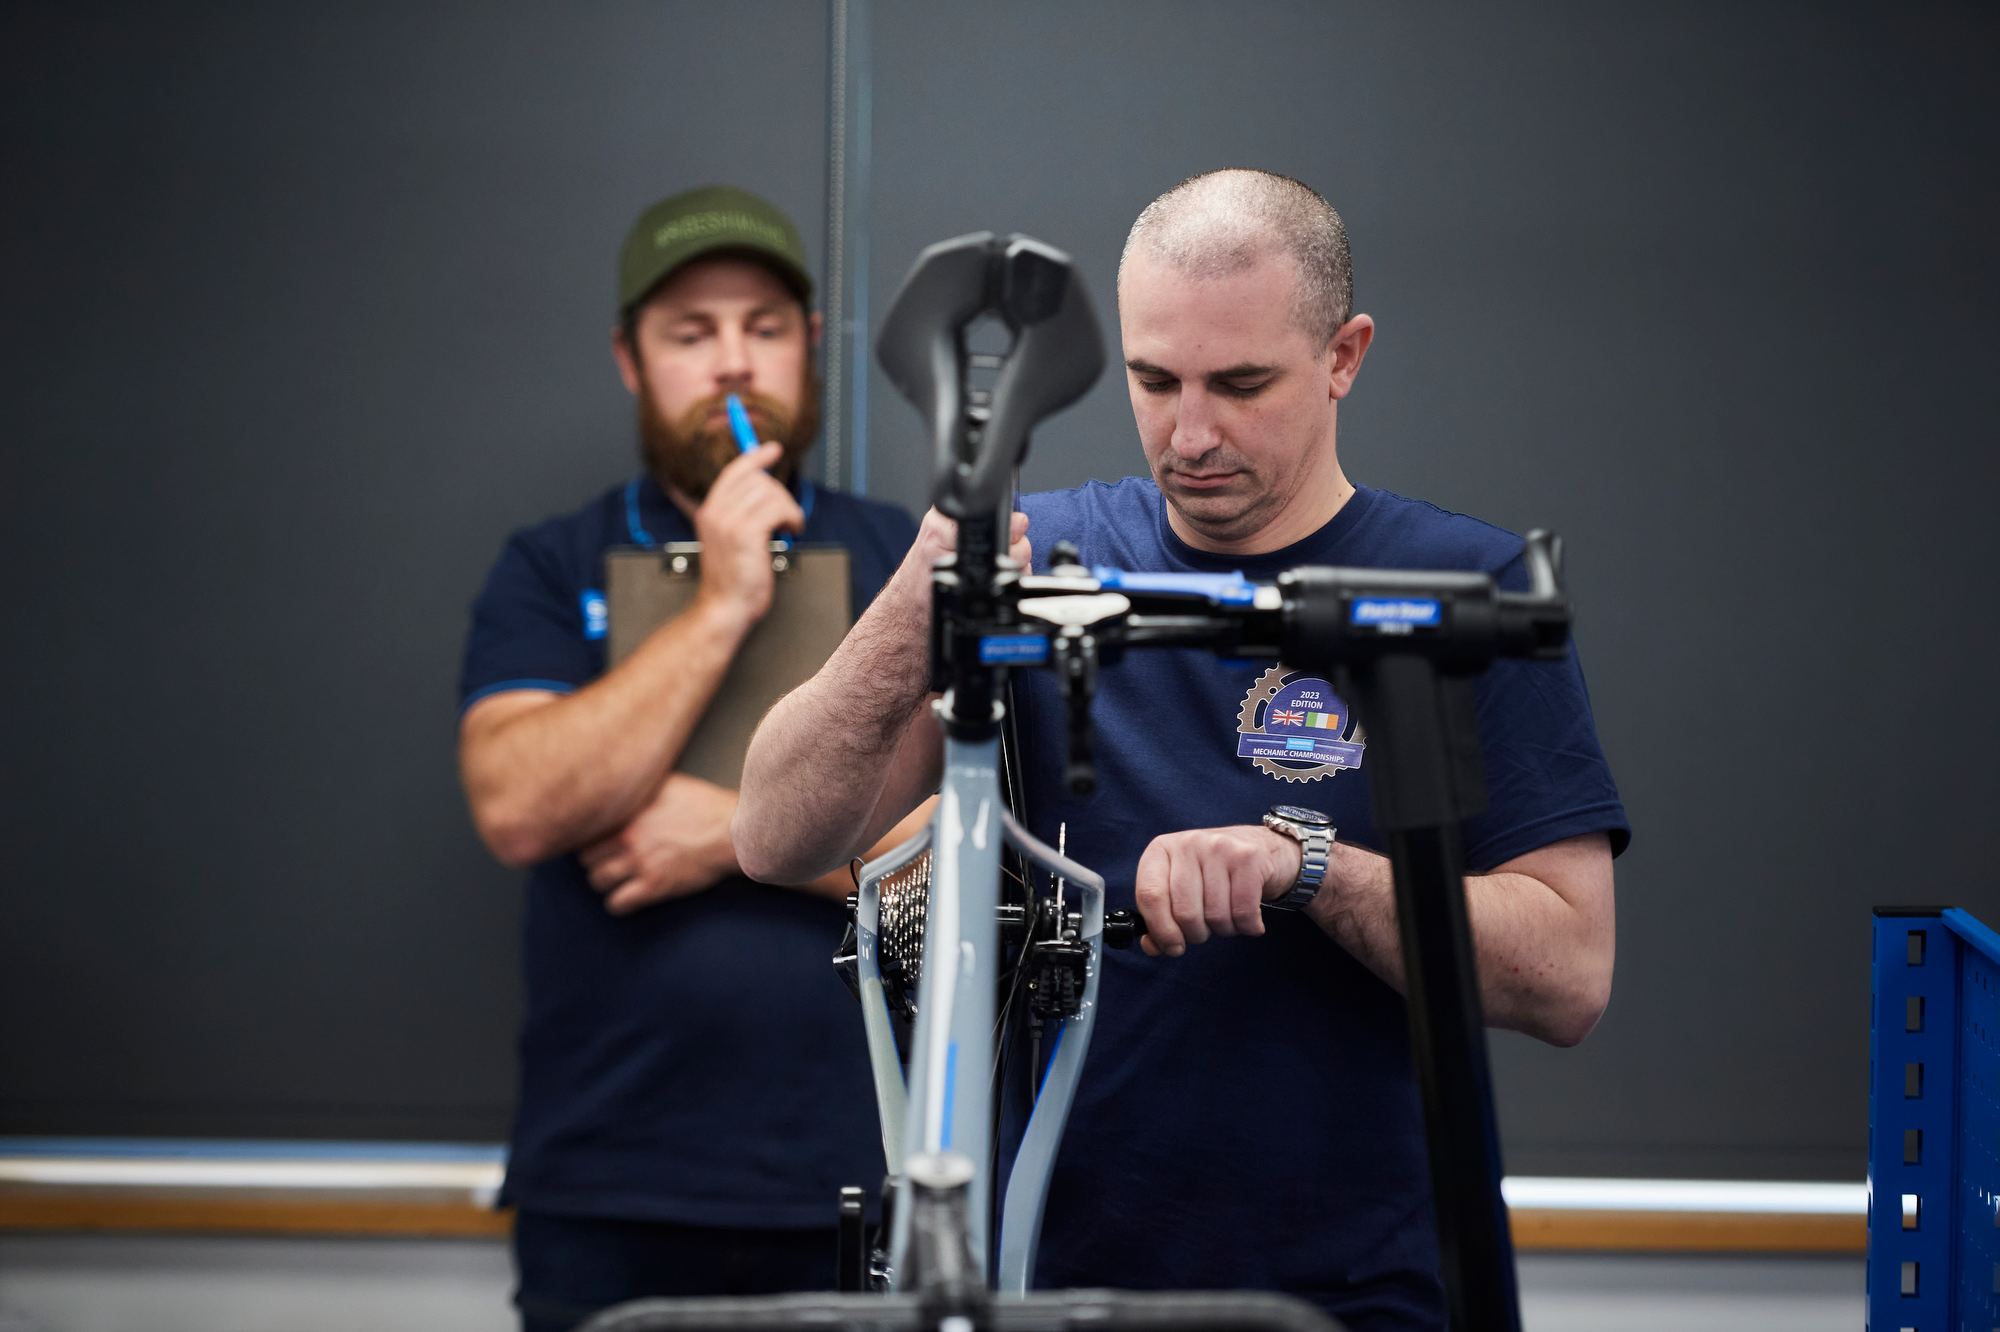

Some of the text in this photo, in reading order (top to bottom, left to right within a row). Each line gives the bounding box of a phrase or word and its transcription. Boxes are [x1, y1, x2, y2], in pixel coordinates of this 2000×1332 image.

[1300, 691, 1320, 699] 2023
[1291, 699, 1323, 709] EDITION
[1253, 748, 1345, 763] MECHANIC CHAMPIONSHIPS
